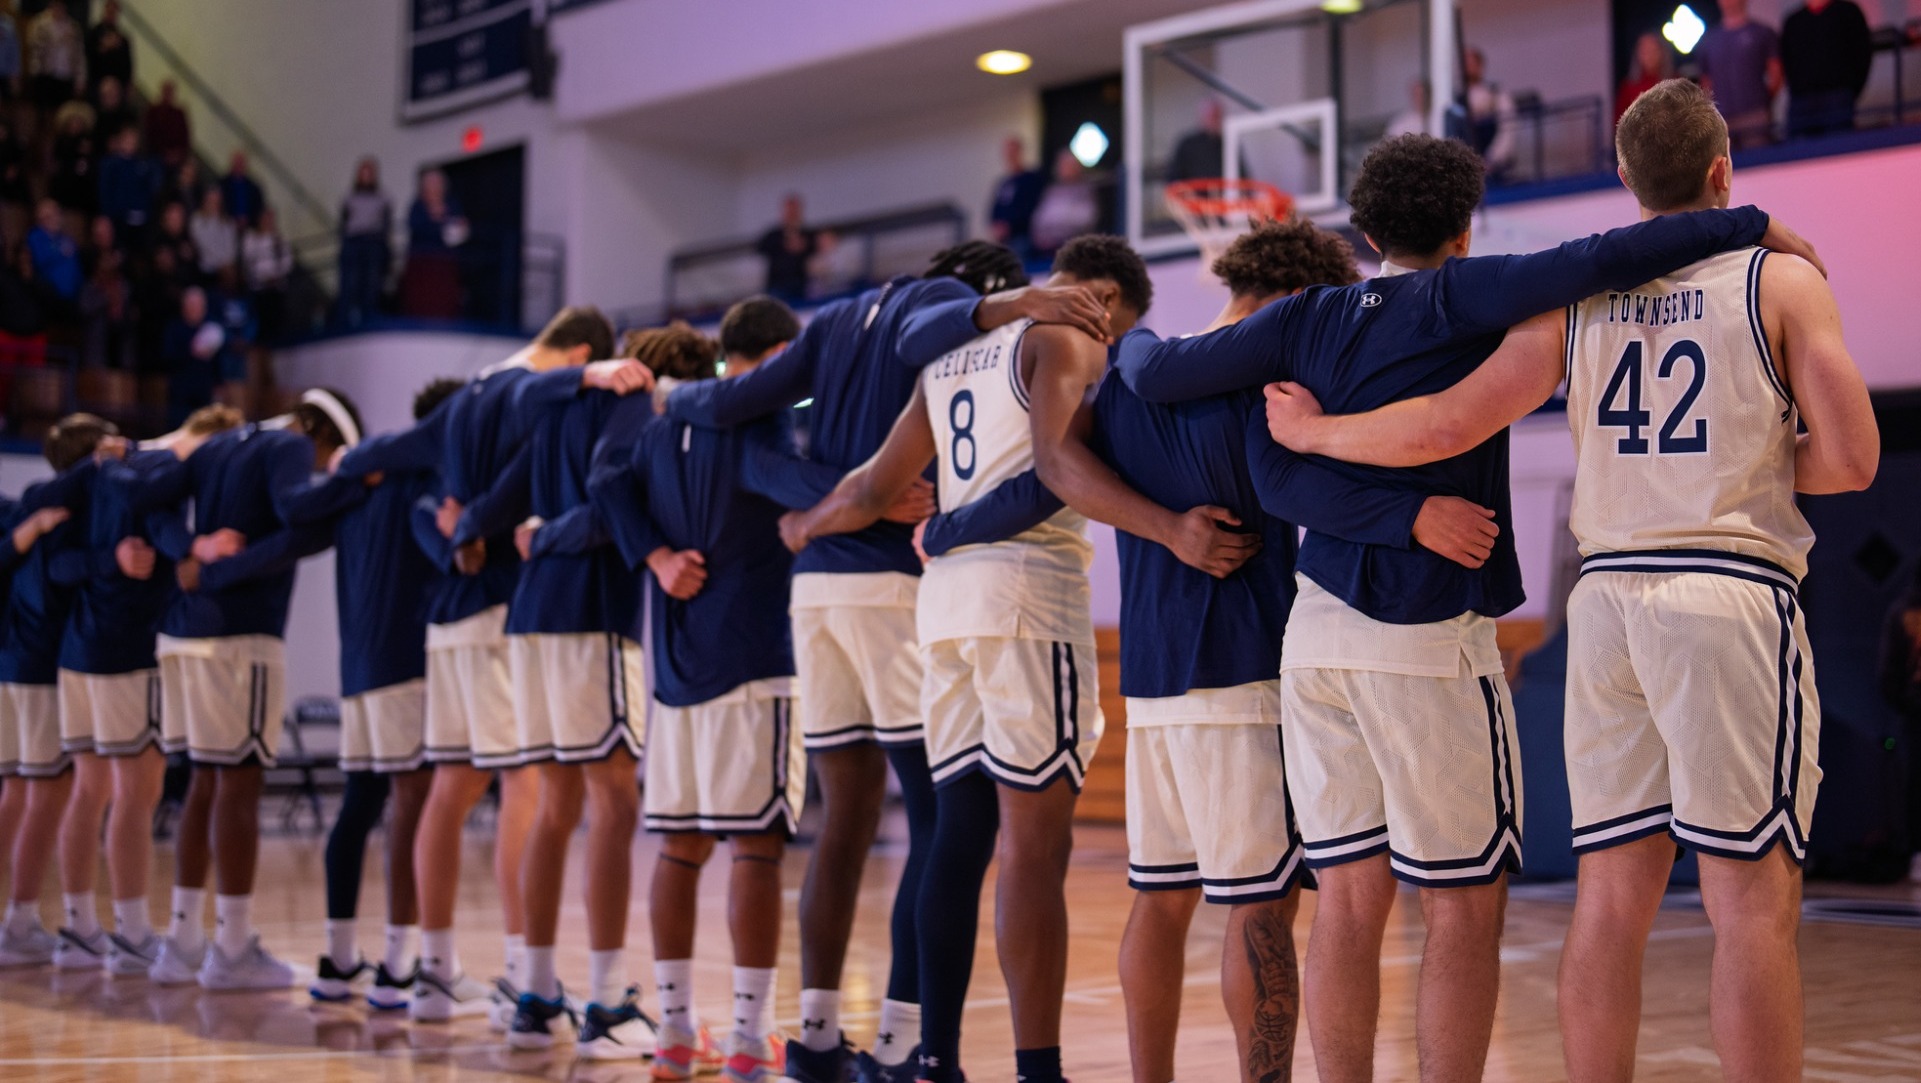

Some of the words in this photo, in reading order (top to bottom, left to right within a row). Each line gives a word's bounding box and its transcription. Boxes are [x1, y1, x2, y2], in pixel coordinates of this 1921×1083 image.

[1608, 289, 1704, 326] TOWNSEND
[949, 389, 977, 481] 8
[1597, 339, 1707, 454] 42
